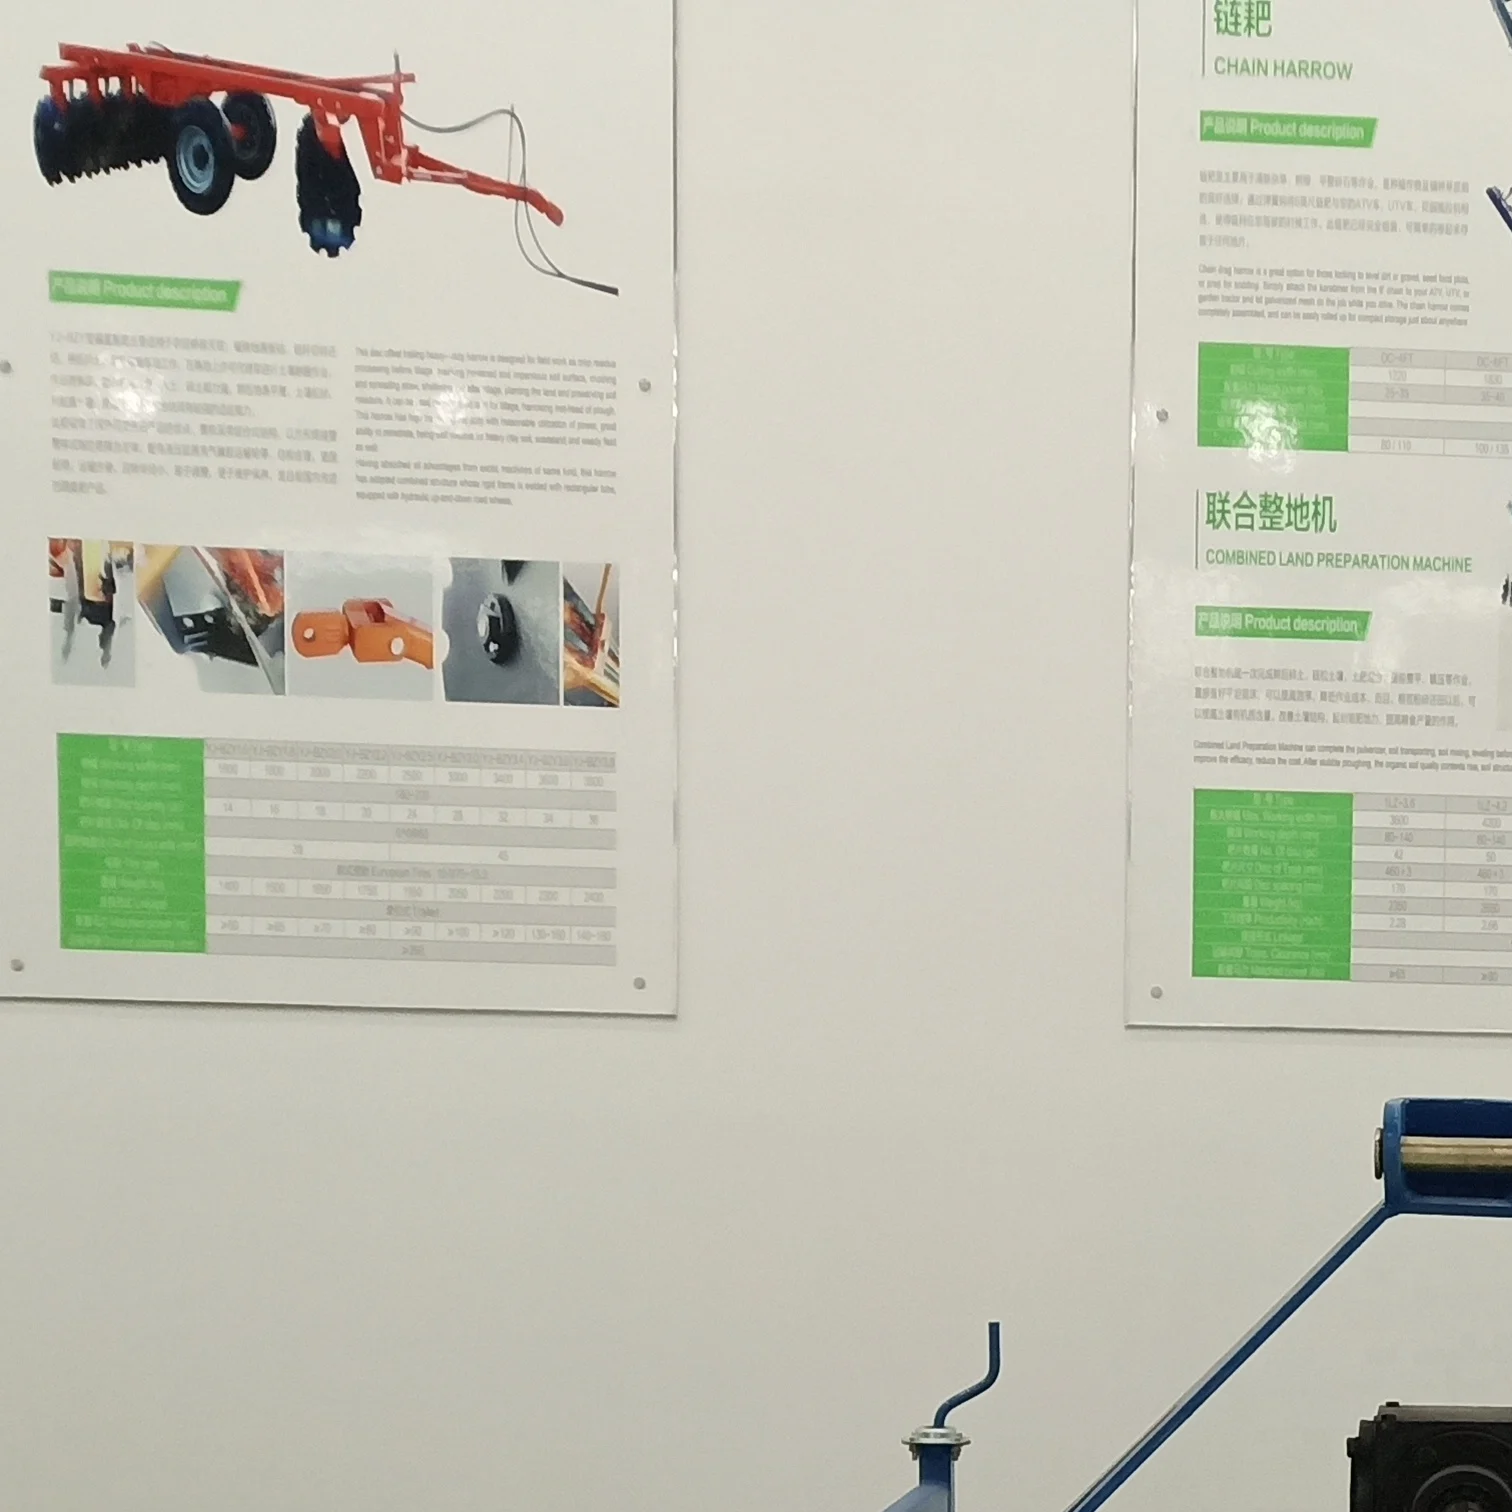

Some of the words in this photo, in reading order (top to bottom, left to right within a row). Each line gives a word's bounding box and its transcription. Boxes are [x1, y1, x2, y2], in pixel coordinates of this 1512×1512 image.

[1214, 0, 1271, 38] 链耙
[1214, 56, 1269, 77] CHAIN
[1273, 58, 1354, 81] HARROW
[1251, 117, 1297, 138] Product
[1300, 120, 1365, 142] description
[103, 278, 154, 299] Product
[155, 282, 228, 304] description
[1205, 490, 1337, 534] 联合整地机
[1205, 548, 1276, 567] COMBINED
[1279, 551, 1314, 568] LAND
[1317, 553, 1410, 571] PREPARATION
[1412, 556, 1472, 573] MACHINE
[1245, 613, 1291, 632] Product
[1293, 615, 1359, 636] description
